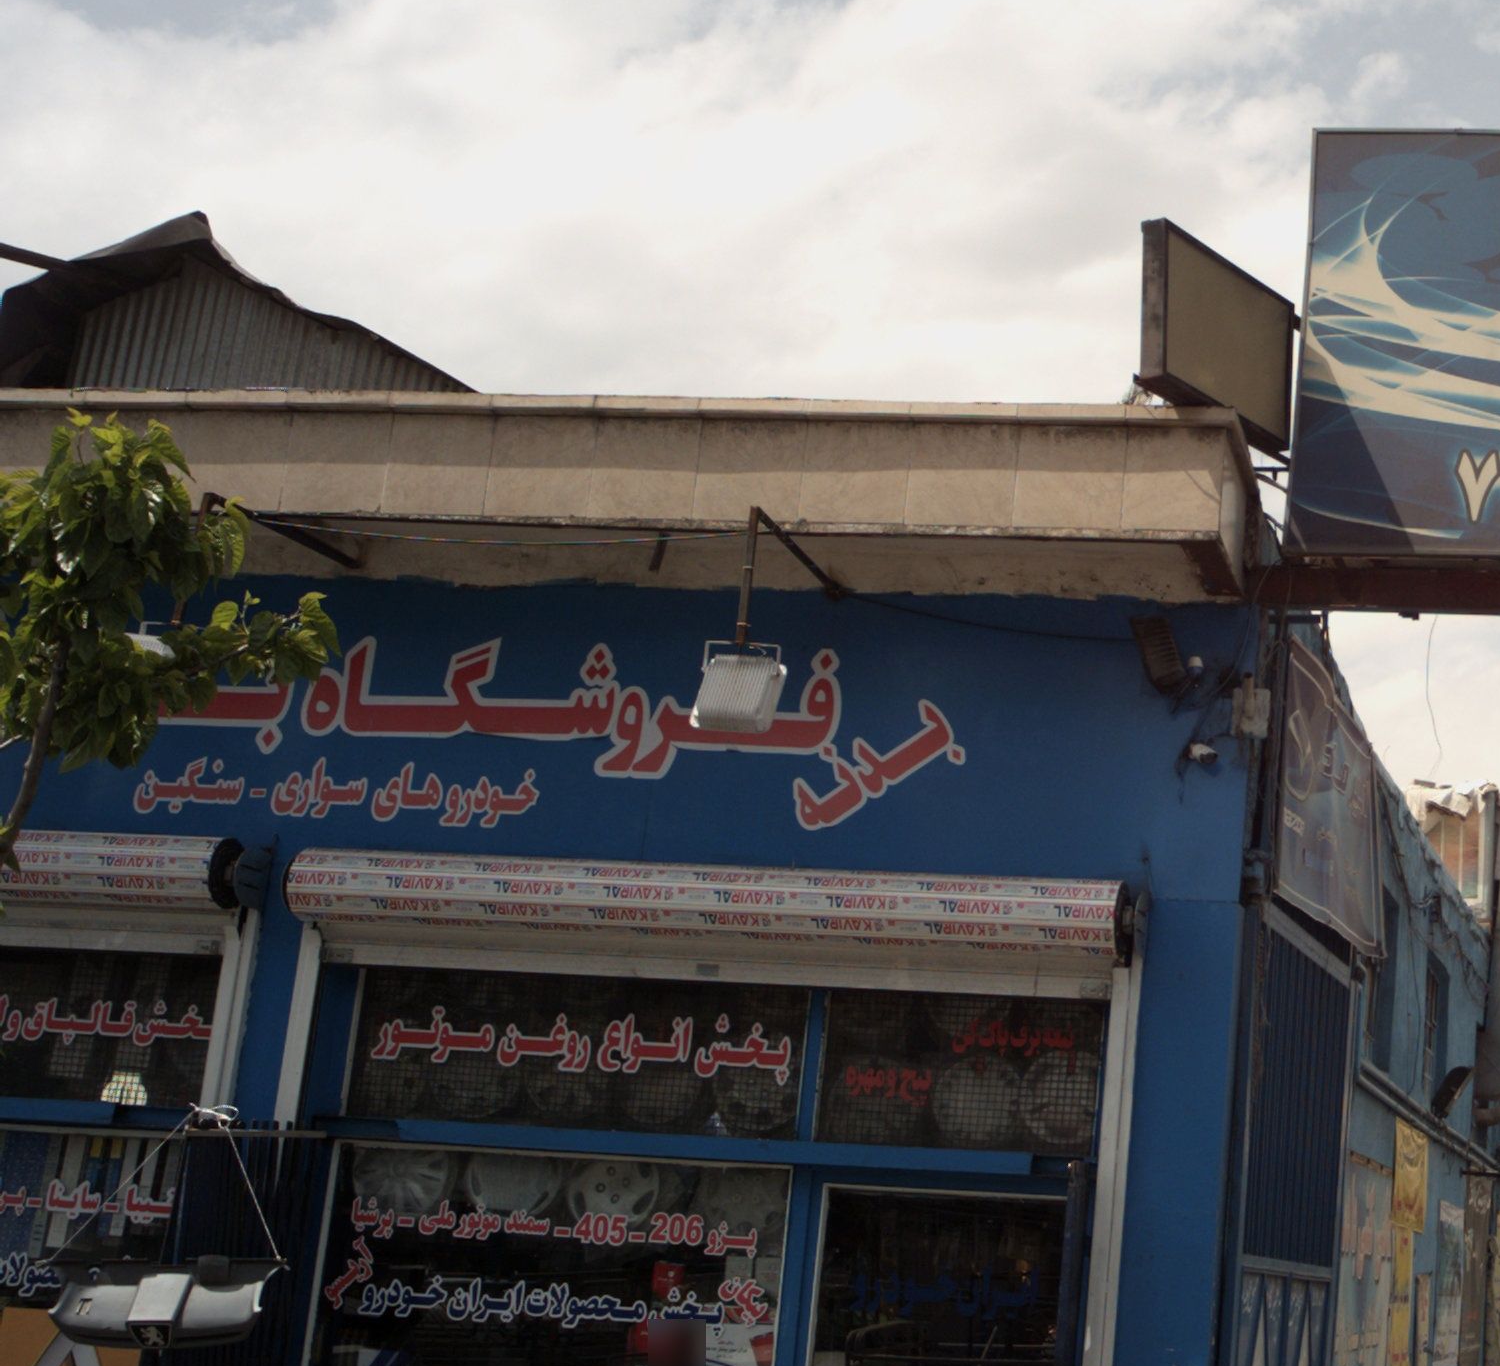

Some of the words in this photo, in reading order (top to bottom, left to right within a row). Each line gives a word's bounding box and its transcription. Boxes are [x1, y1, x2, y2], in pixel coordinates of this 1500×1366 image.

[302, 636, 841, 779] فروشگاه
[134, 757, 244, 813] سنگین
[272, 757, 366, 817] سواری
[793, 700, 966, 831] بدنه
[372, 762, 440, 821] های
[440, 769, 540, 827] خودرو
[134, 1000, 213, 1047] خش
[372, 1006, 495, 1062] موتور
[497, 1012, 590, 1072] روغن
[598, 1014, 693, 1073] انواع
[695, 1014, 792, 1085] پخش
[351, 1196, 394, 1239] پرشیا
[419, 1200, 455, 1234] ملی
[453, 1209, 502, 1239] موتور
[504, 1205, 549, 1235] سمند
[573, 1212, 628, 1244] 405
[650, 1214, 703, 1245] 206
[704, 1223, 757, 1258] پژو
[358, 1275, 447, 1322] خودرو
[446, 1279, 525, 1322] ایران
[525, 1281, 647, 1328] محصولات
